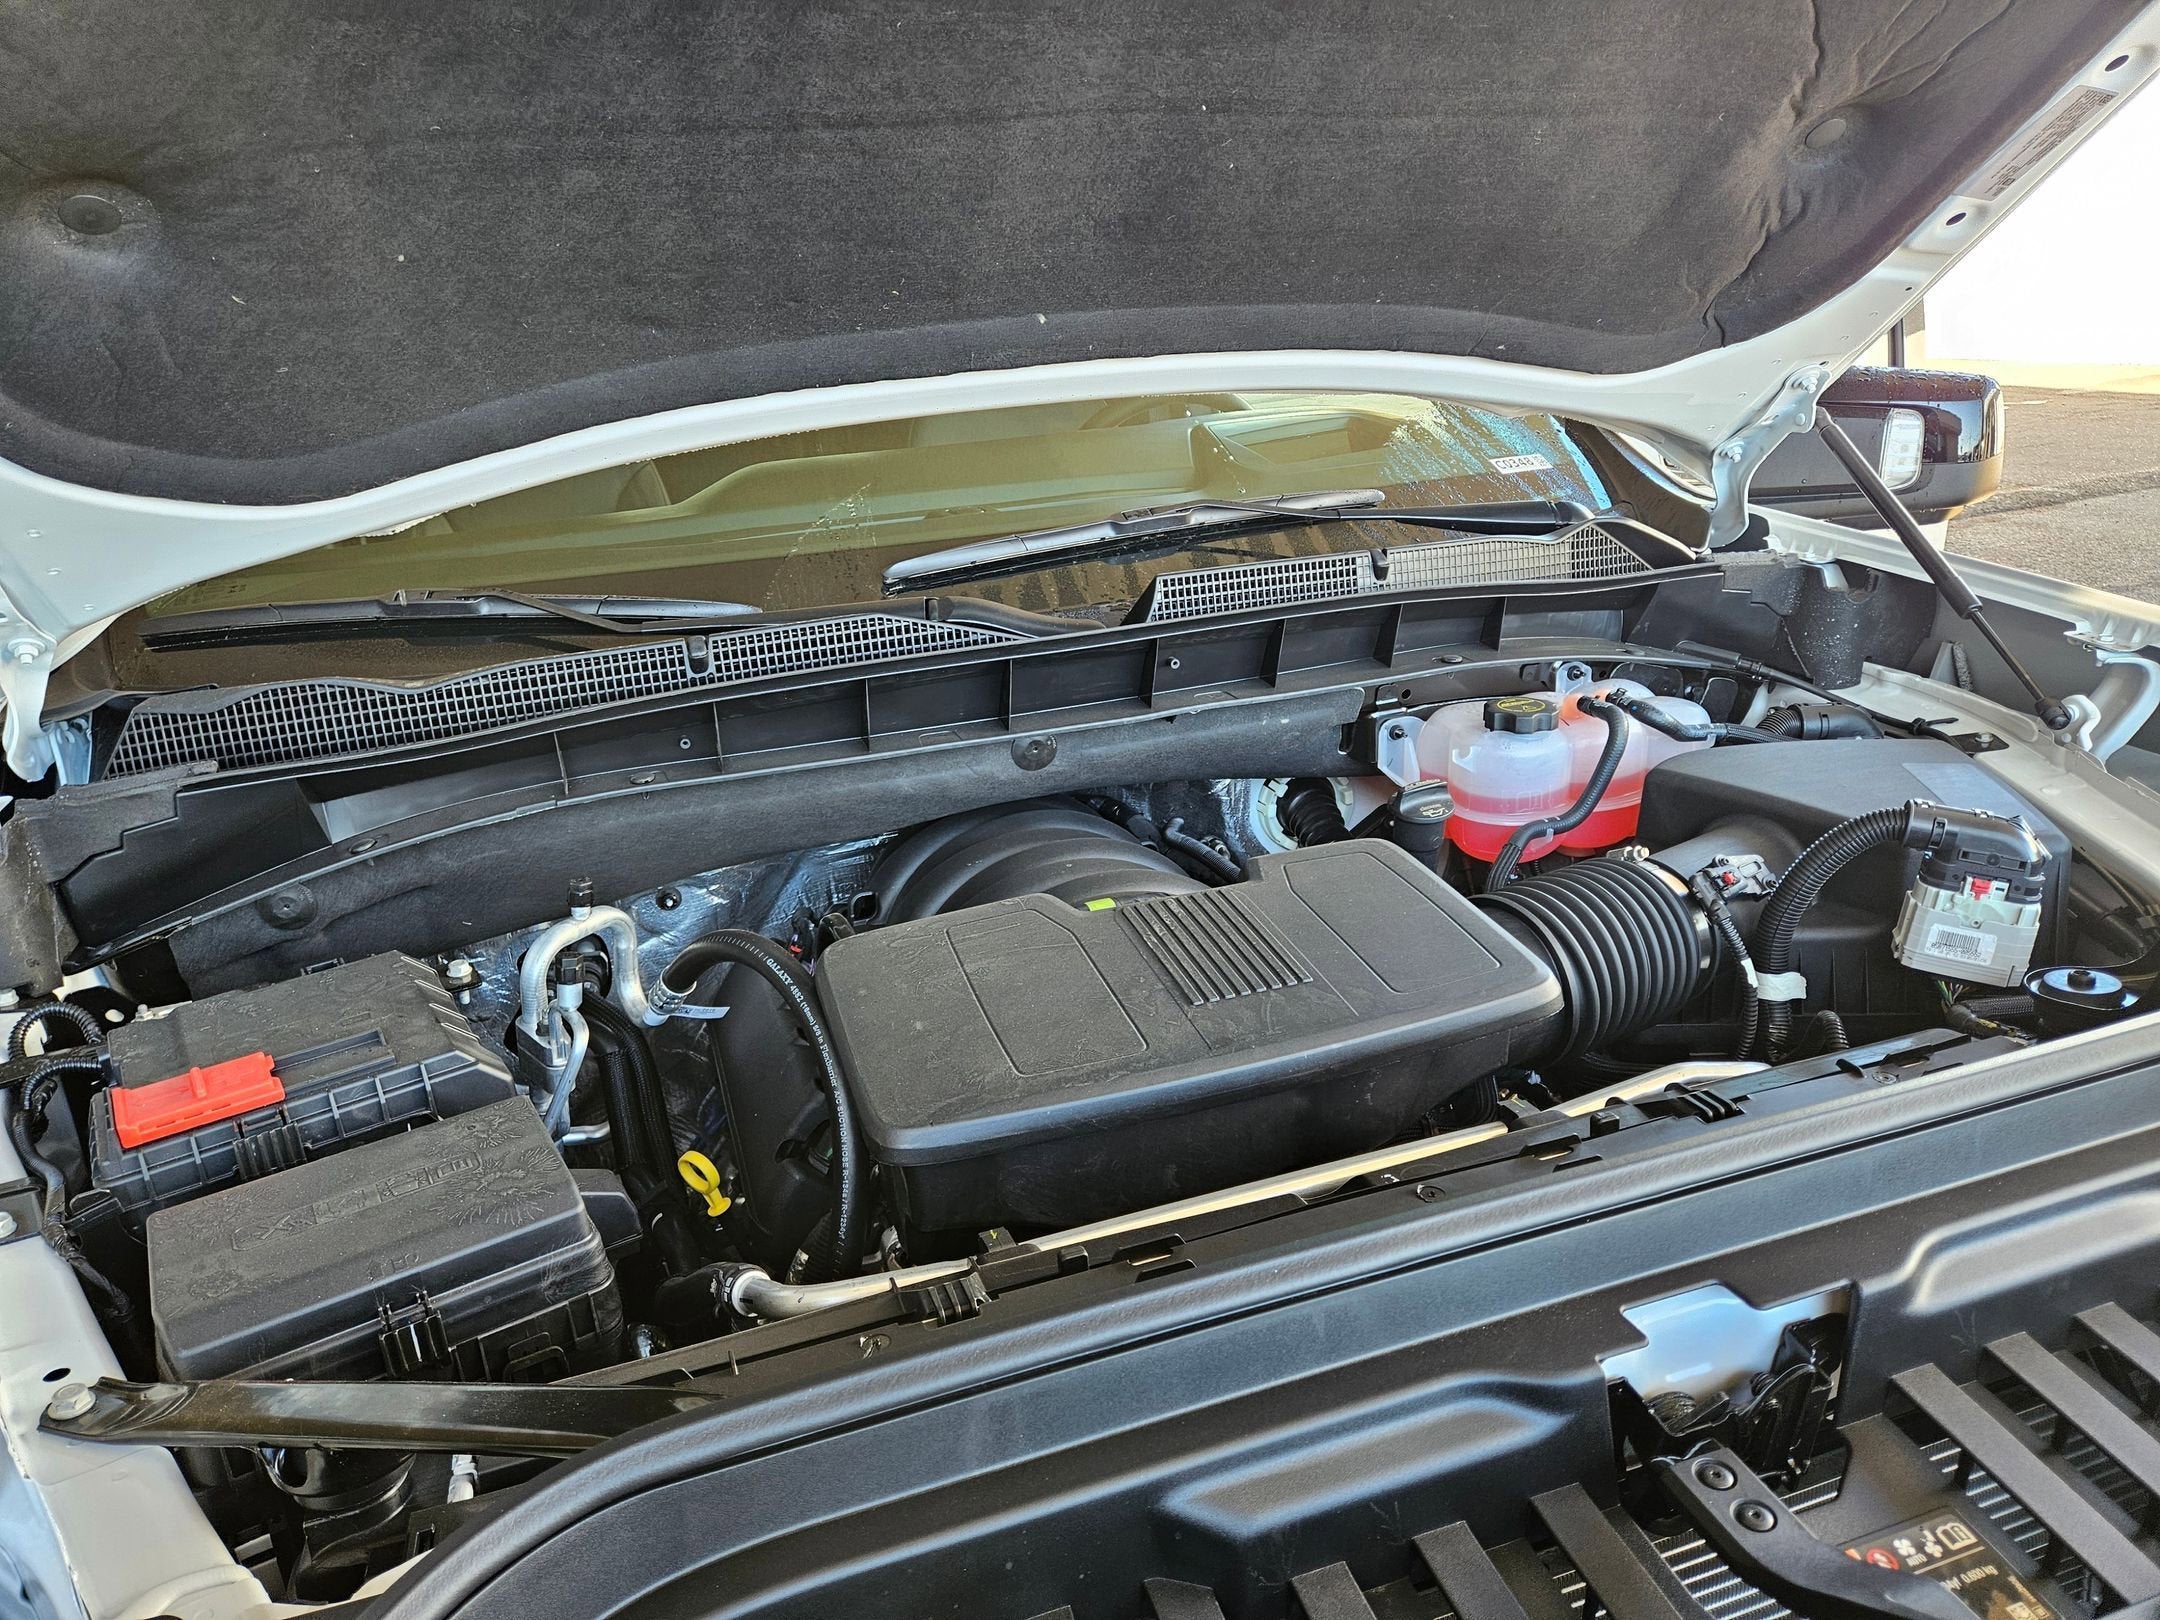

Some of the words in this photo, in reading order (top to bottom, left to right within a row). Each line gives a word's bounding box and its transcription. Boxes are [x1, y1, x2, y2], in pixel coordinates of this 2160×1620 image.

[766, 958, 792, 985] GALAXY
[816, 1035, 824, 1044] in
[833, 1089, 842, 1104] A/C
[837, 1105, 848, 1143] SUCTION
[841, 1144, 849, 1168] HOSE
